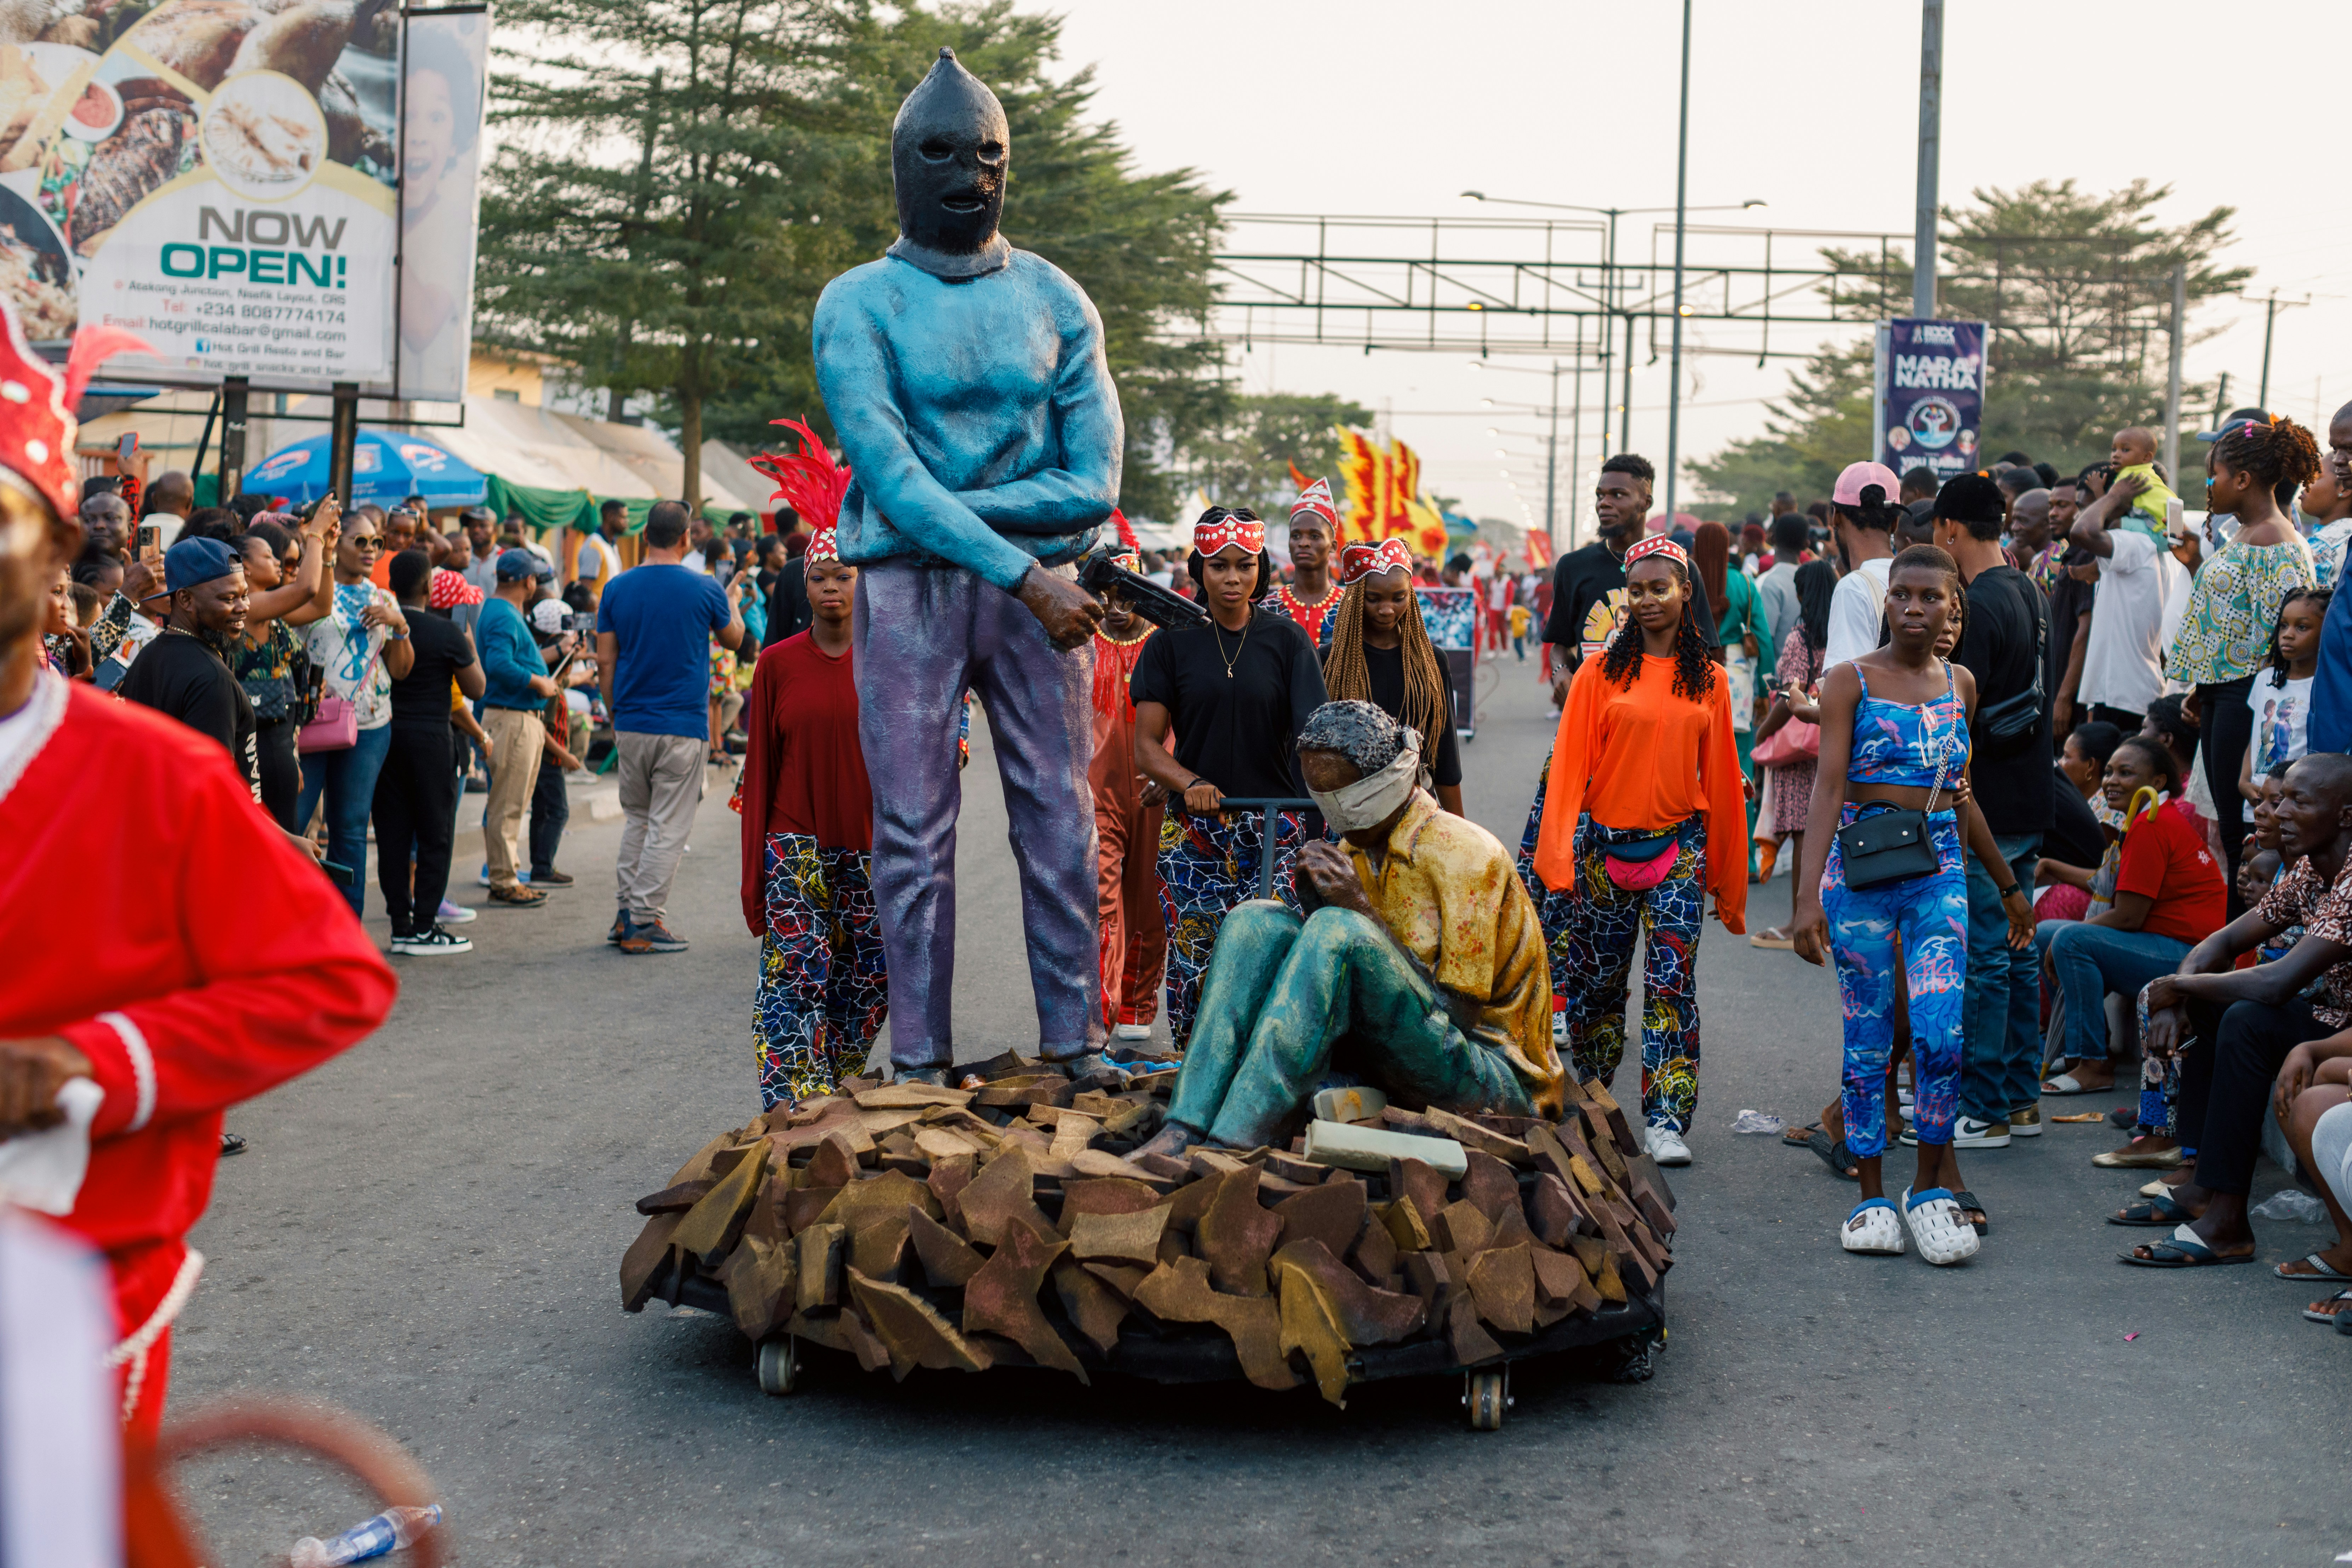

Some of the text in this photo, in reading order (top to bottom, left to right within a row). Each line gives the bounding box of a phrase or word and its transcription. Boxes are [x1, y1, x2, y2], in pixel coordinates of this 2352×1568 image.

[199, 206, 347, 249] NOW
[161, 242, 346, 288] OPEN!
[196, 302, 234, 317] +234
[241, 304, 345, 324] 8087774174
[149, 316, 346, 341] hotgrillcalabar@gmail.com
[238, 342, 260, 354] Grill
[301, 348, 321, 358] and
[325, 348, 346, 359] Bar
[1895, 370, 1978, 390] NATHA
[1901, 456, 1927, 467] YOU
[1583, 600, 1609, 641] OUR
